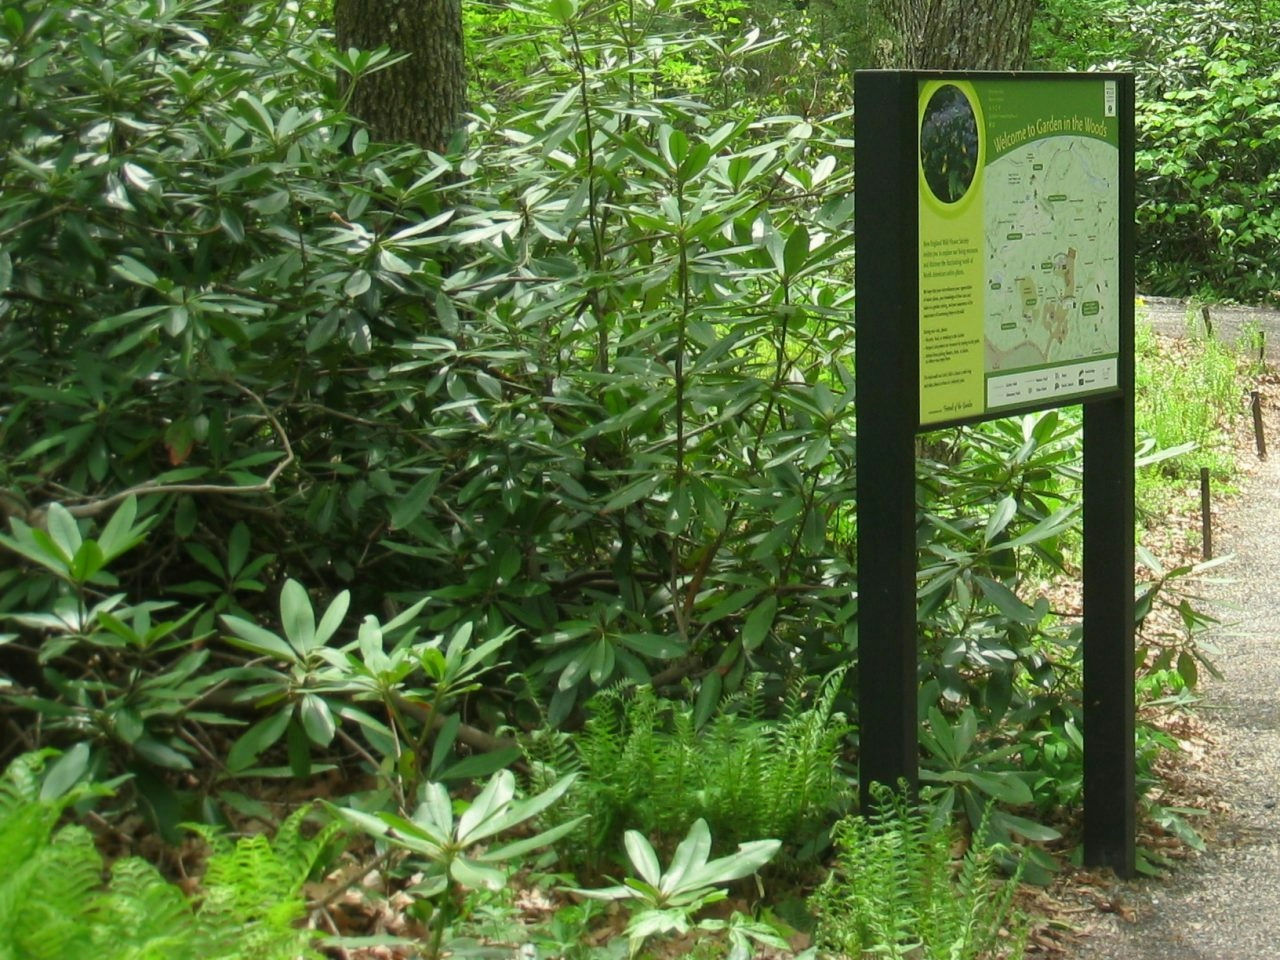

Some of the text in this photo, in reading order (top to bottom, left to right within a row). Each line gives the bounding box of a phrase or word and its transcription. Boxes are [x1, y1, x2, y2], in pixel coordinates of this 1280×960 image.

[993, 114, 1108, 153] Welcome to Garden in the Woods
